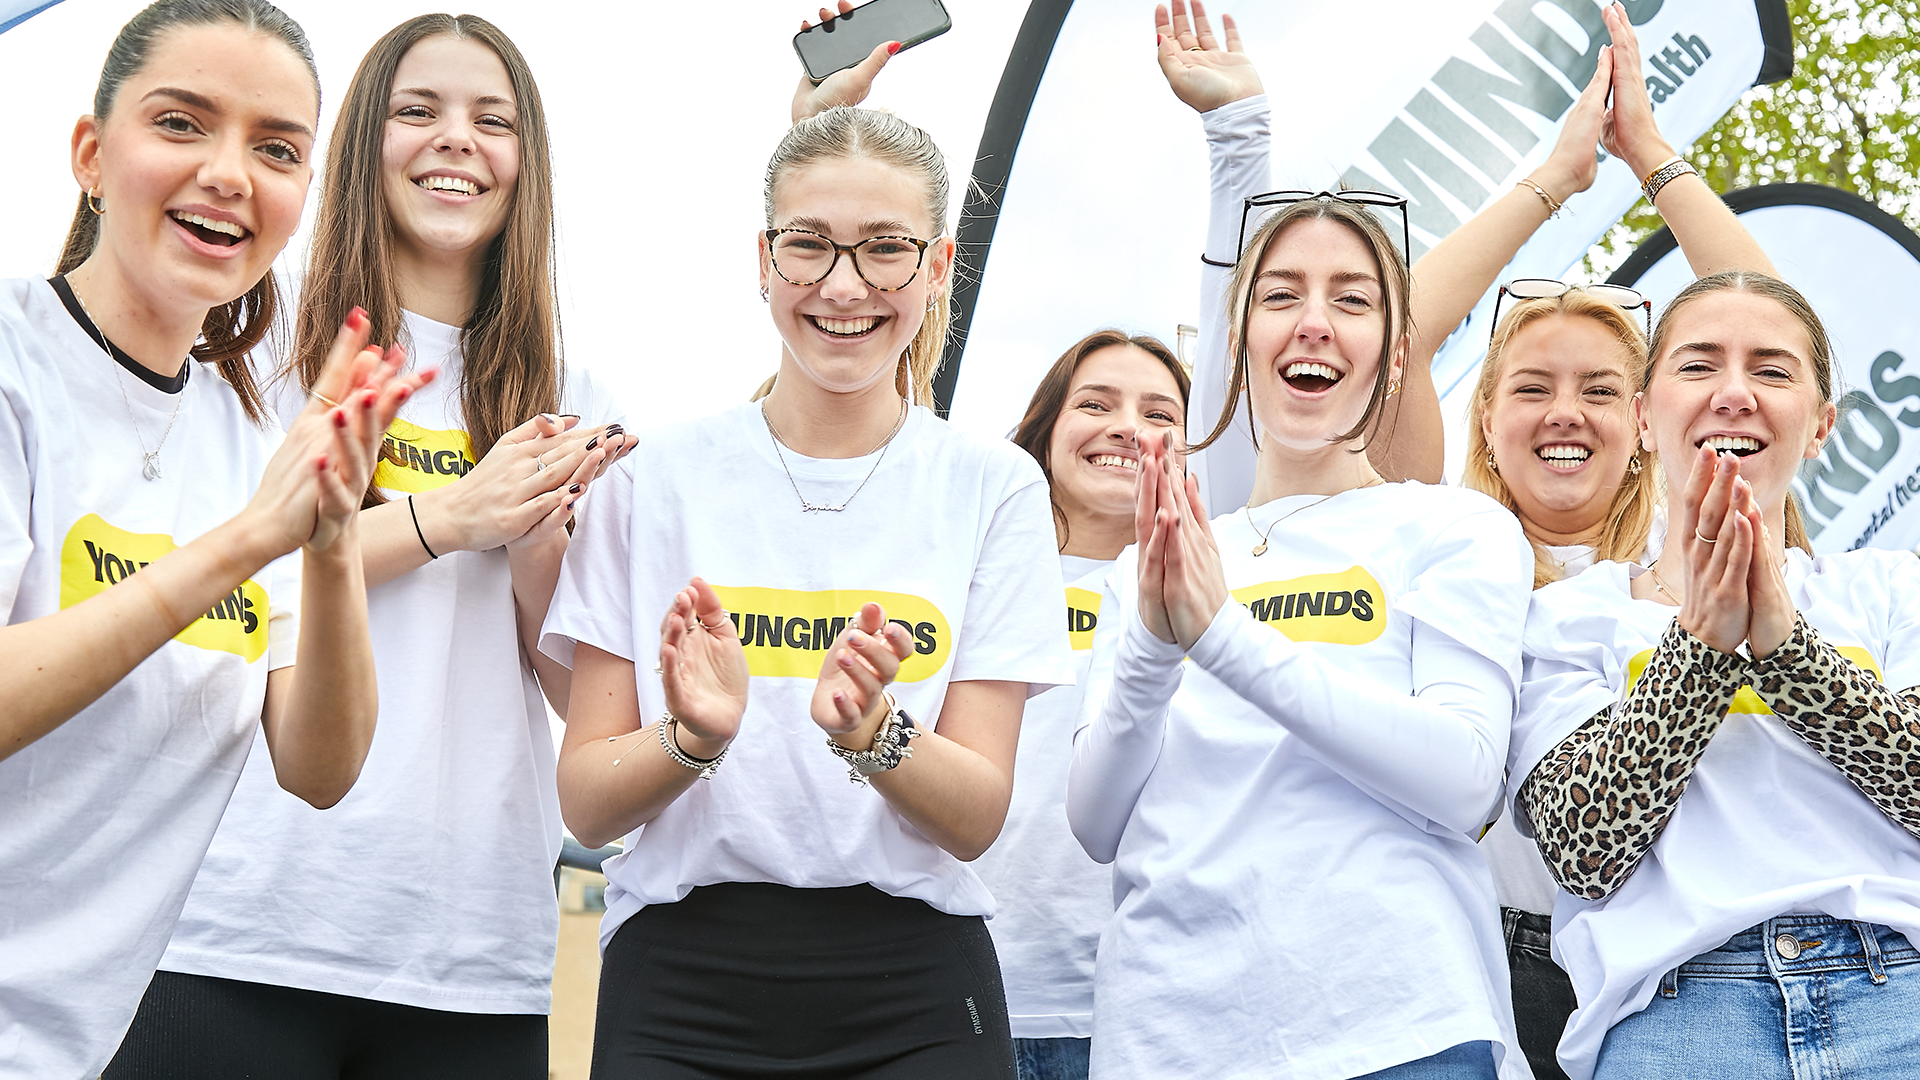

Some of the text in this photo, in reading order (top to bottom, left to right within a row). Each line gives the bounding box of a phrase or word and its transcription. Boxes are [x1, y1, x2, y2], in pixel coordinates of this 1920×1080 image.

[1646, 32, 1712, 112] alth
[1845, 491, 1894, 552] ental
[1240, 589, 1374, 622] MINDS
[965, 996, 983, 1035] GYMSHARK
